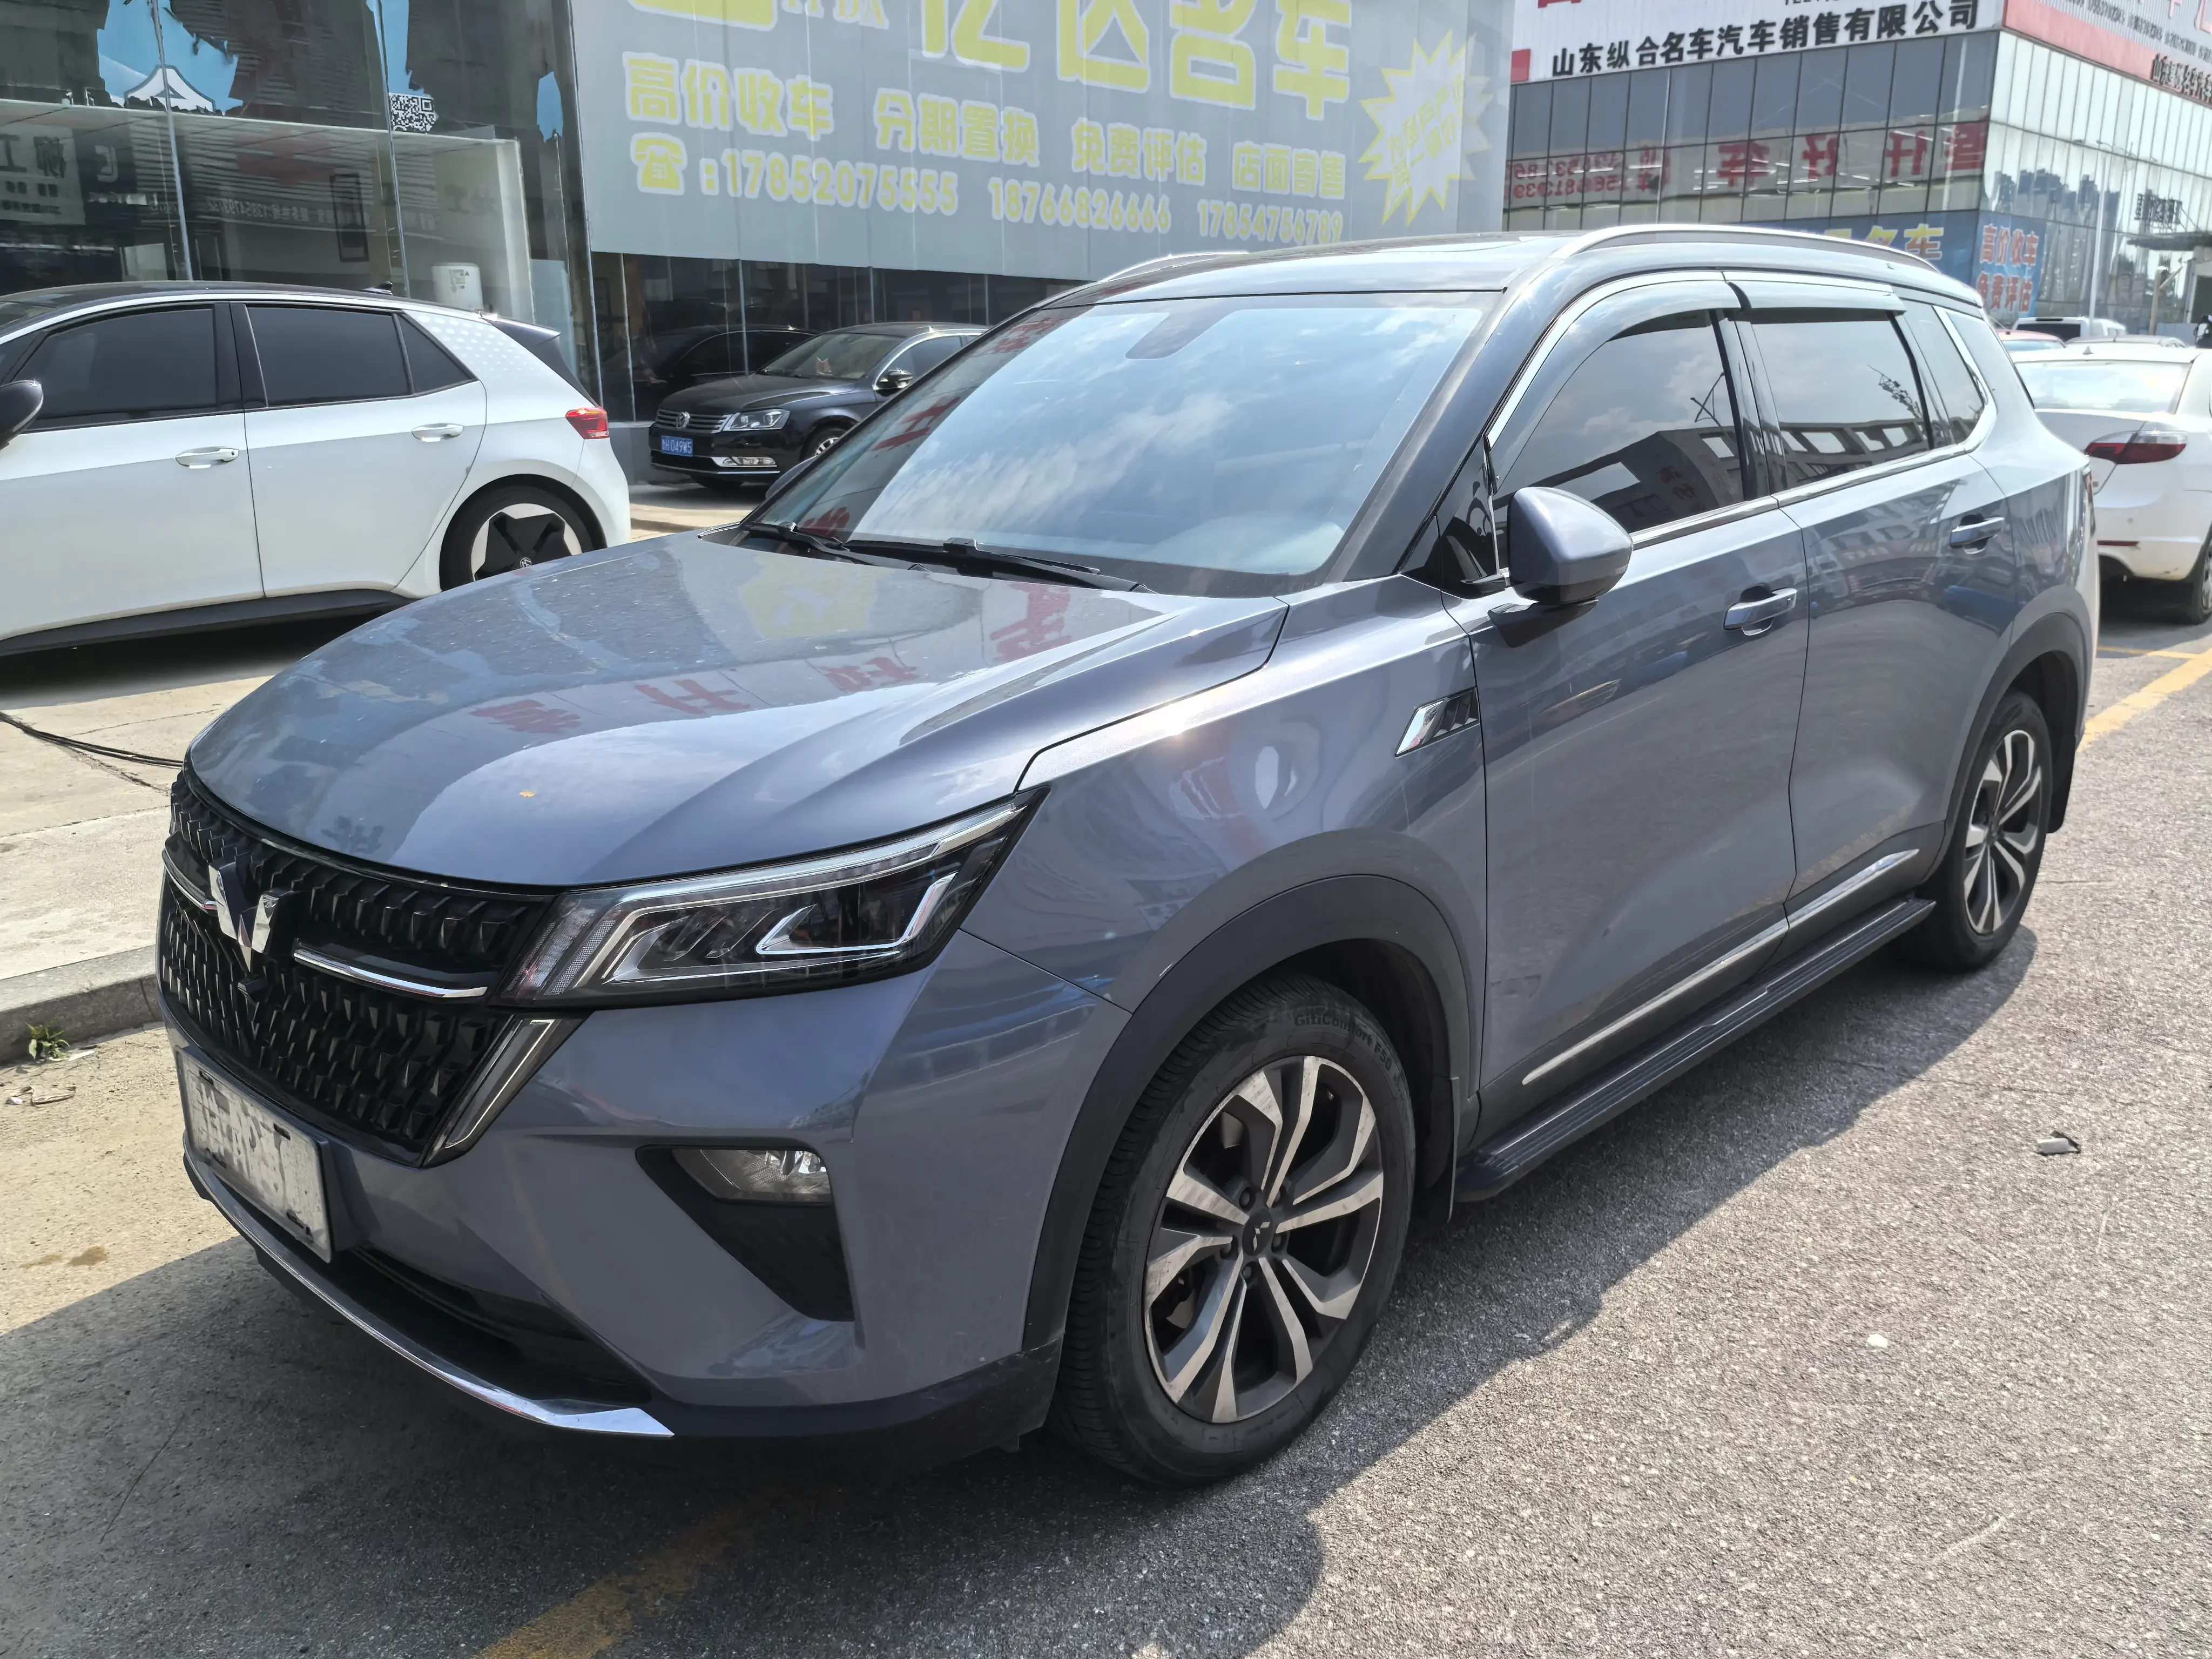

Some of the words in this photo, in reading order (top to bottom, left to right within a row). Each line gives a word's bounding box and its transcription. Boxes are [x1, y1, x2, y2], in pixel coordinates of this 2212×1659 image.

[1553, 0, 1979, 76] 山东纵合名车汽车销售有限公司
[624, 52, 834, 141] 高价收车
[874, 87, 1039, 167] 分期置换
[1071, 118, 1206, 186] 免费评估
[1232, 140, 1346, 200] 店面寄售
[987, 177, 1171, 233] 18766826666
[1197, 199, 1343, 244] 17854756789
[1981, 223, 2039, 267] 高价收车
[1976, 271, 2033, 313] 免费评估
[1373, 1042, 1392, 1071] F50
